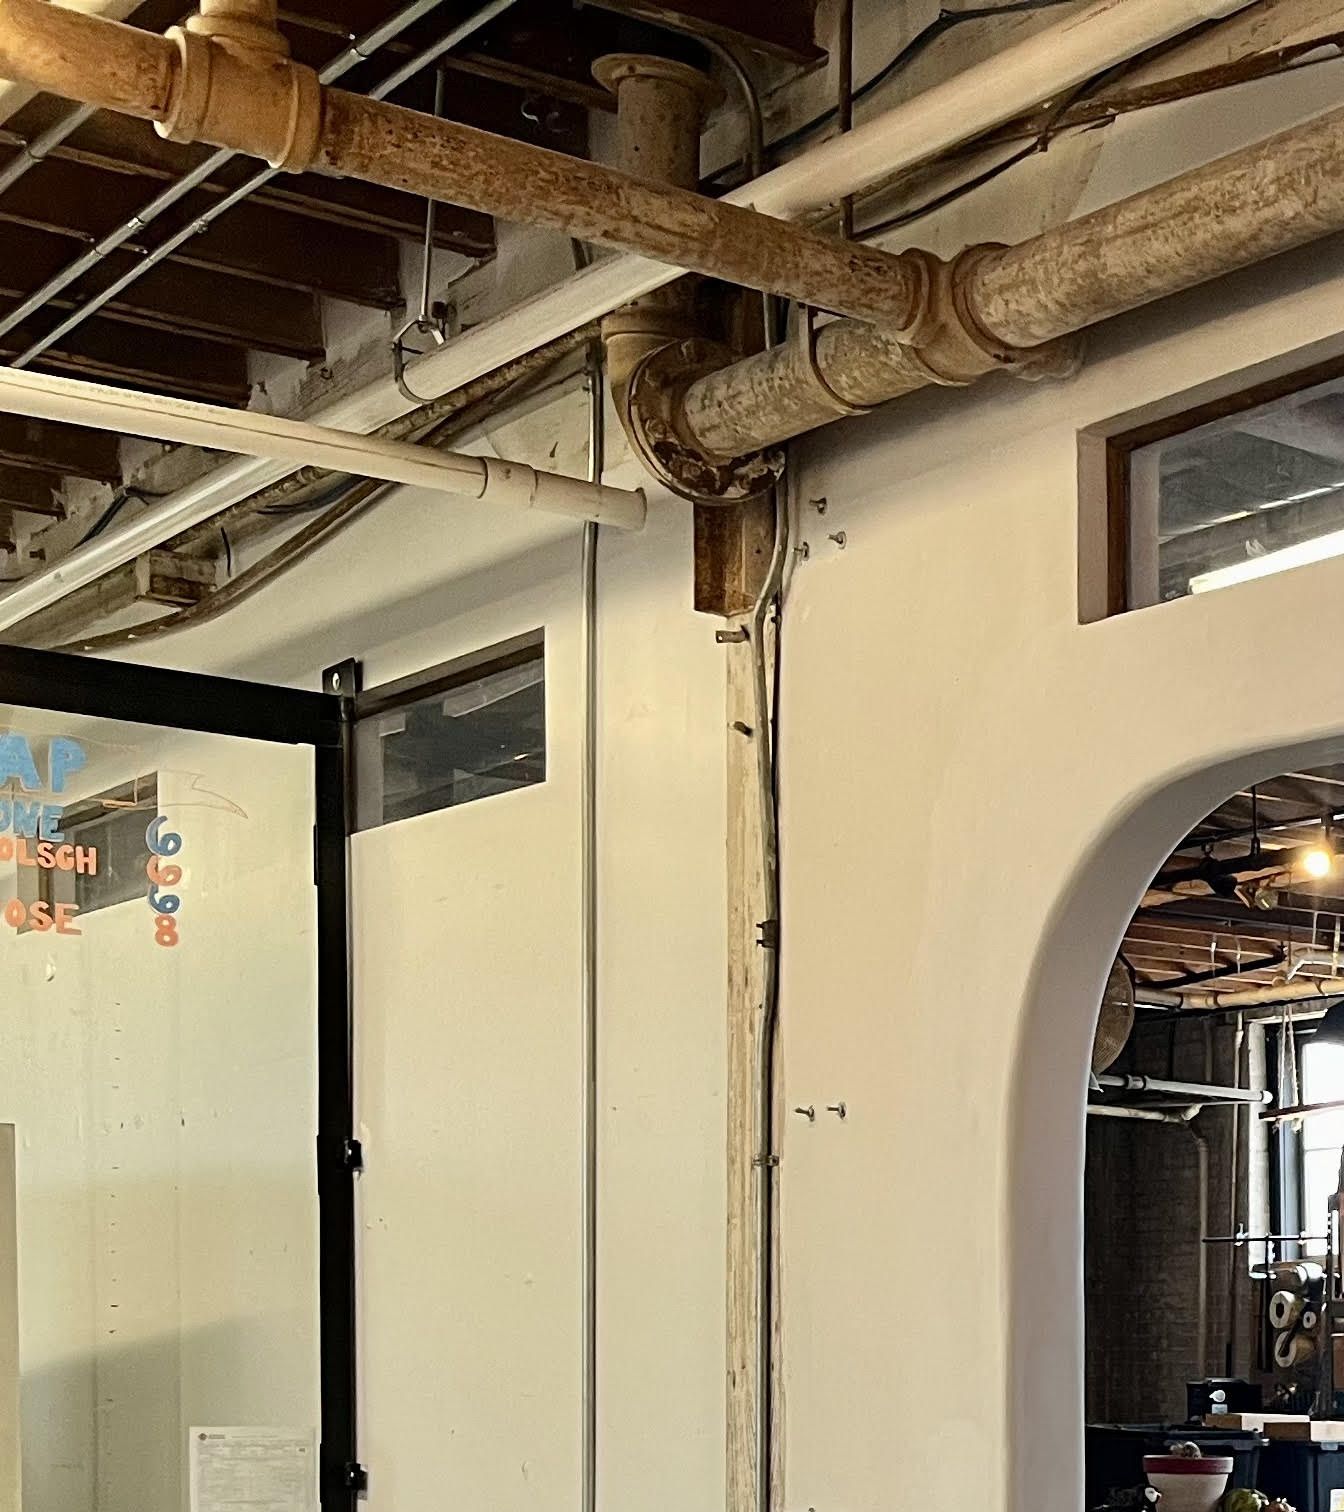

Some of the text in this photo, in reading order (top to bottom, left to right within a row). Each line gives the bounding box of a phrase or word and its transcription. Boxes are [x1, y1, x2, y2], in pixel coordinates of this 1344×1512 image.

[146, 815, 182, 857] 6
[146, 855, 182, 886] 6
[148, 884, 180, 914] 6
[155, 914, 178, 947] 8
